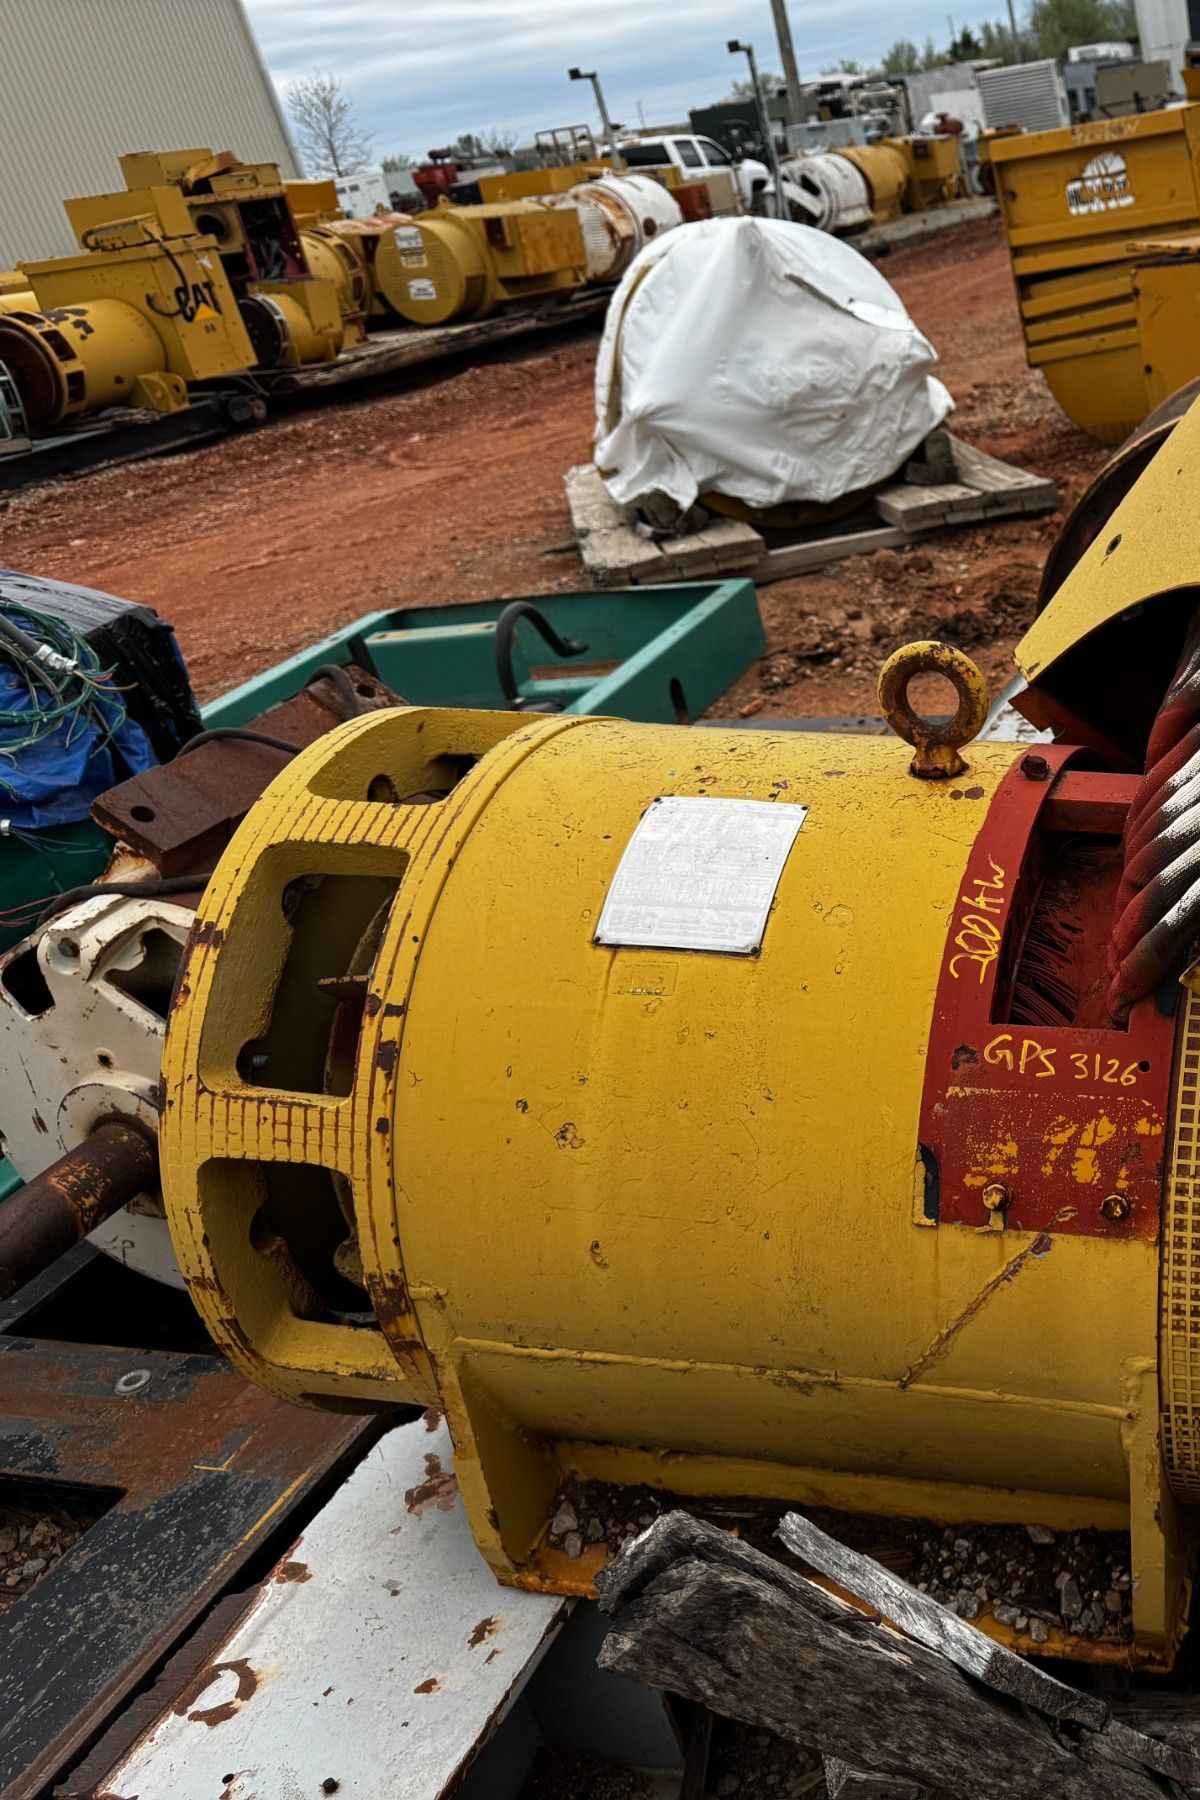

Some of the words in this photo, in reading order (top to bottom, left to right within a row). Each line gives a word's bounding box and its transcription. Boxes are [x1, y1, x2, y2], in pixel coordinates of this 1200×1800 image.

[174, 282, 222, 322] CAT
[984, 1034, 1056, 1077] GPS
[1069, 1053, 1138, 1086] 3126
